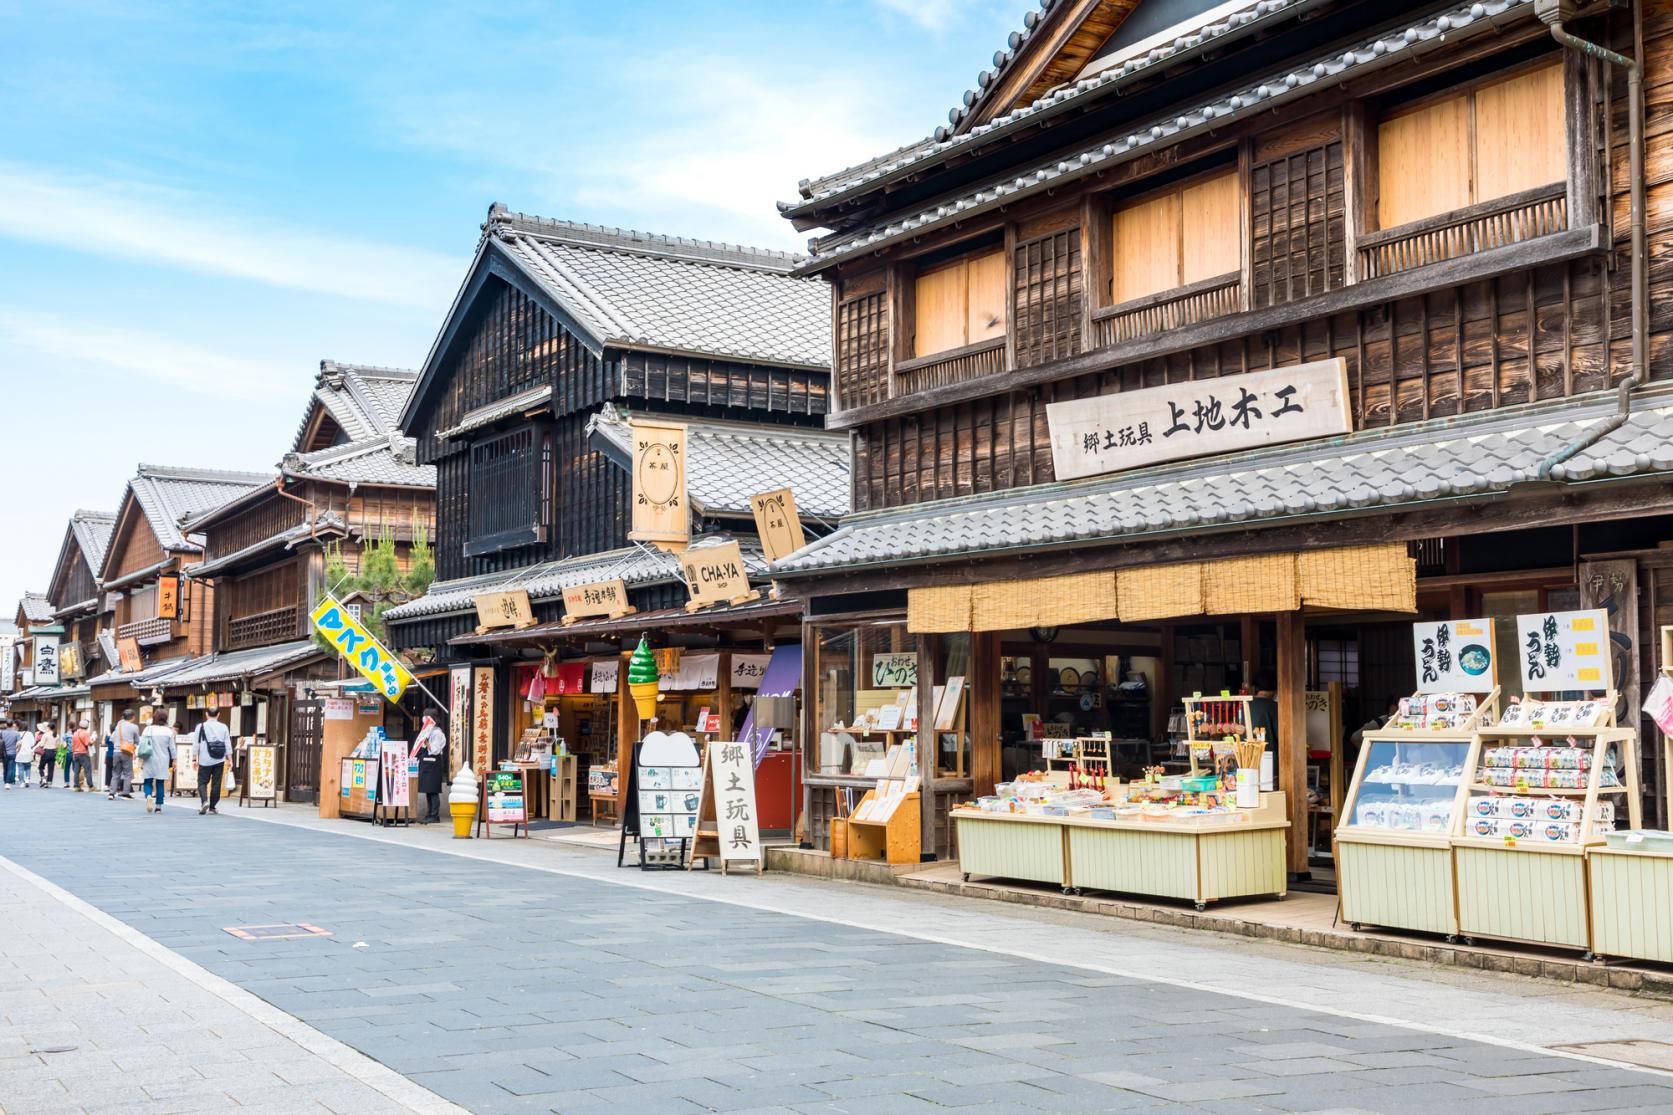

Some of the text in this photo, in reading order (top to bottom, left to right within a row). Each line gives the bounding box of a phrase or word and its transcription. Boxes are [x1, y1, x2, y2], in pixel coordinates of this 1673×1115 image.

[1083, 384, 1304, 455] 郷土玩具 上地木工
[649, 462, 669, 471] 茶屋
[317, 607, 379, 672] マスク
[890, 656, 912, 667] おわせ
[1421, 637, 1438, 684] うどん
[1436, 623, 1451, 672] 伊勢
[1526, 630, 1546, 681] うどん
[1543, 615, 1560, 668] 伊勢
[875, 661, 918, 686] ひのき
[720, 743, 753, 850] 郷土玩具
